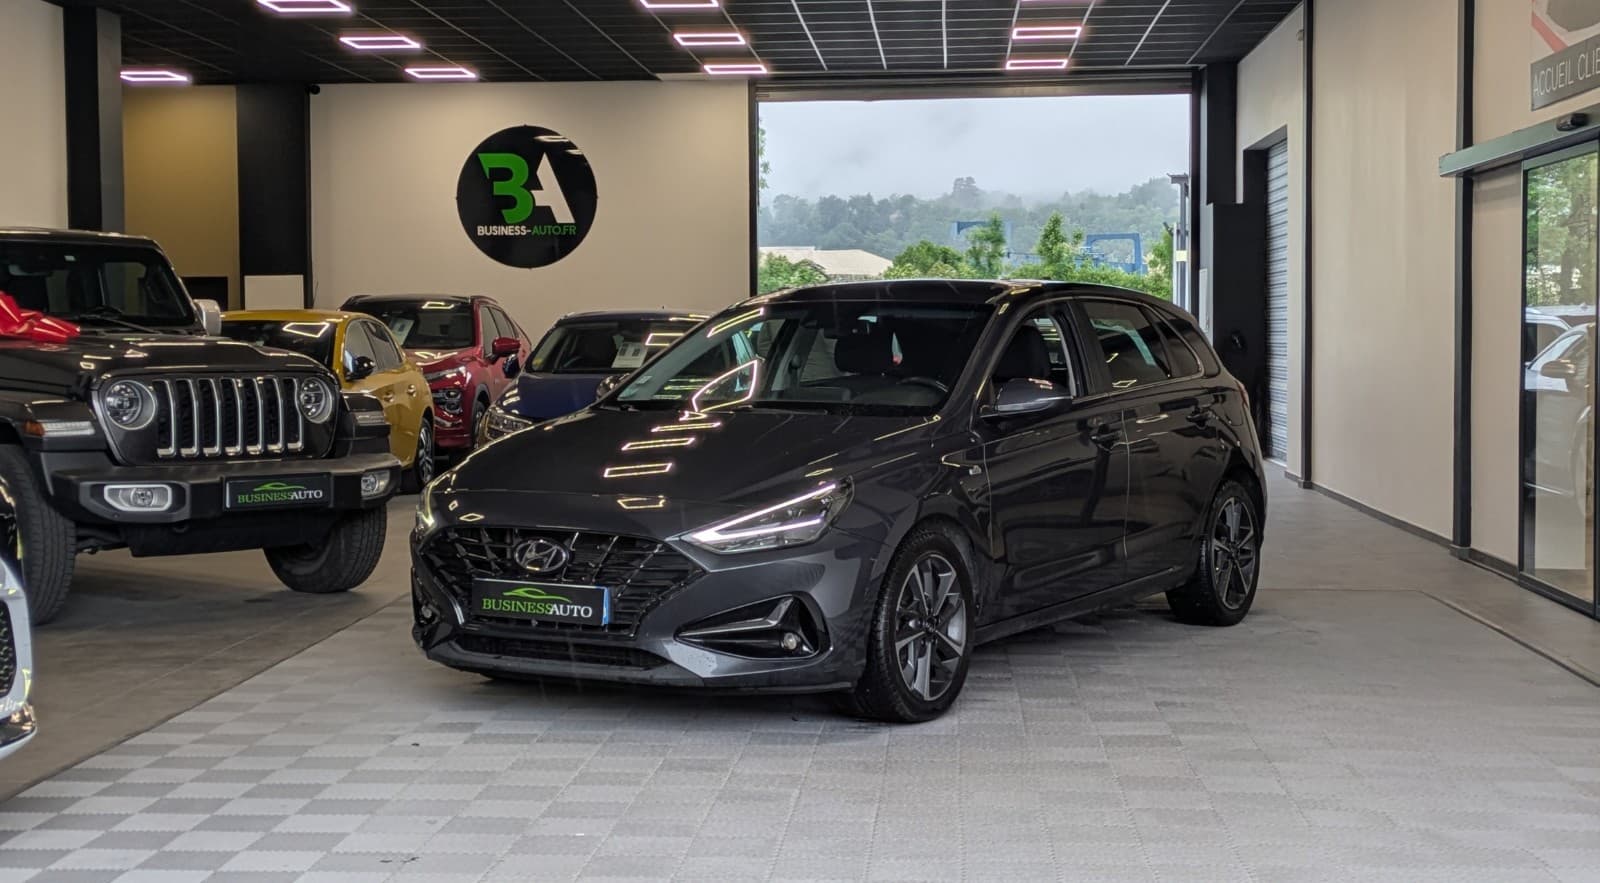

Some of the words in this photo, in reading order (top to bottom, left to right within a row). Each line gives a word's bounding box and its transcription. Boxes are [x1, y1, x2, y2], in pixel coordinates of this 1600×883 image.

[1533, 58, 1574, 96] ACCUEIL
[477, 225, 577, 236] BUSINESS-AUTO.FR
[237, 489, 323, 504] BUSINESSAUTO
[482, 598, 593, 618] BUSINESSAUTO
